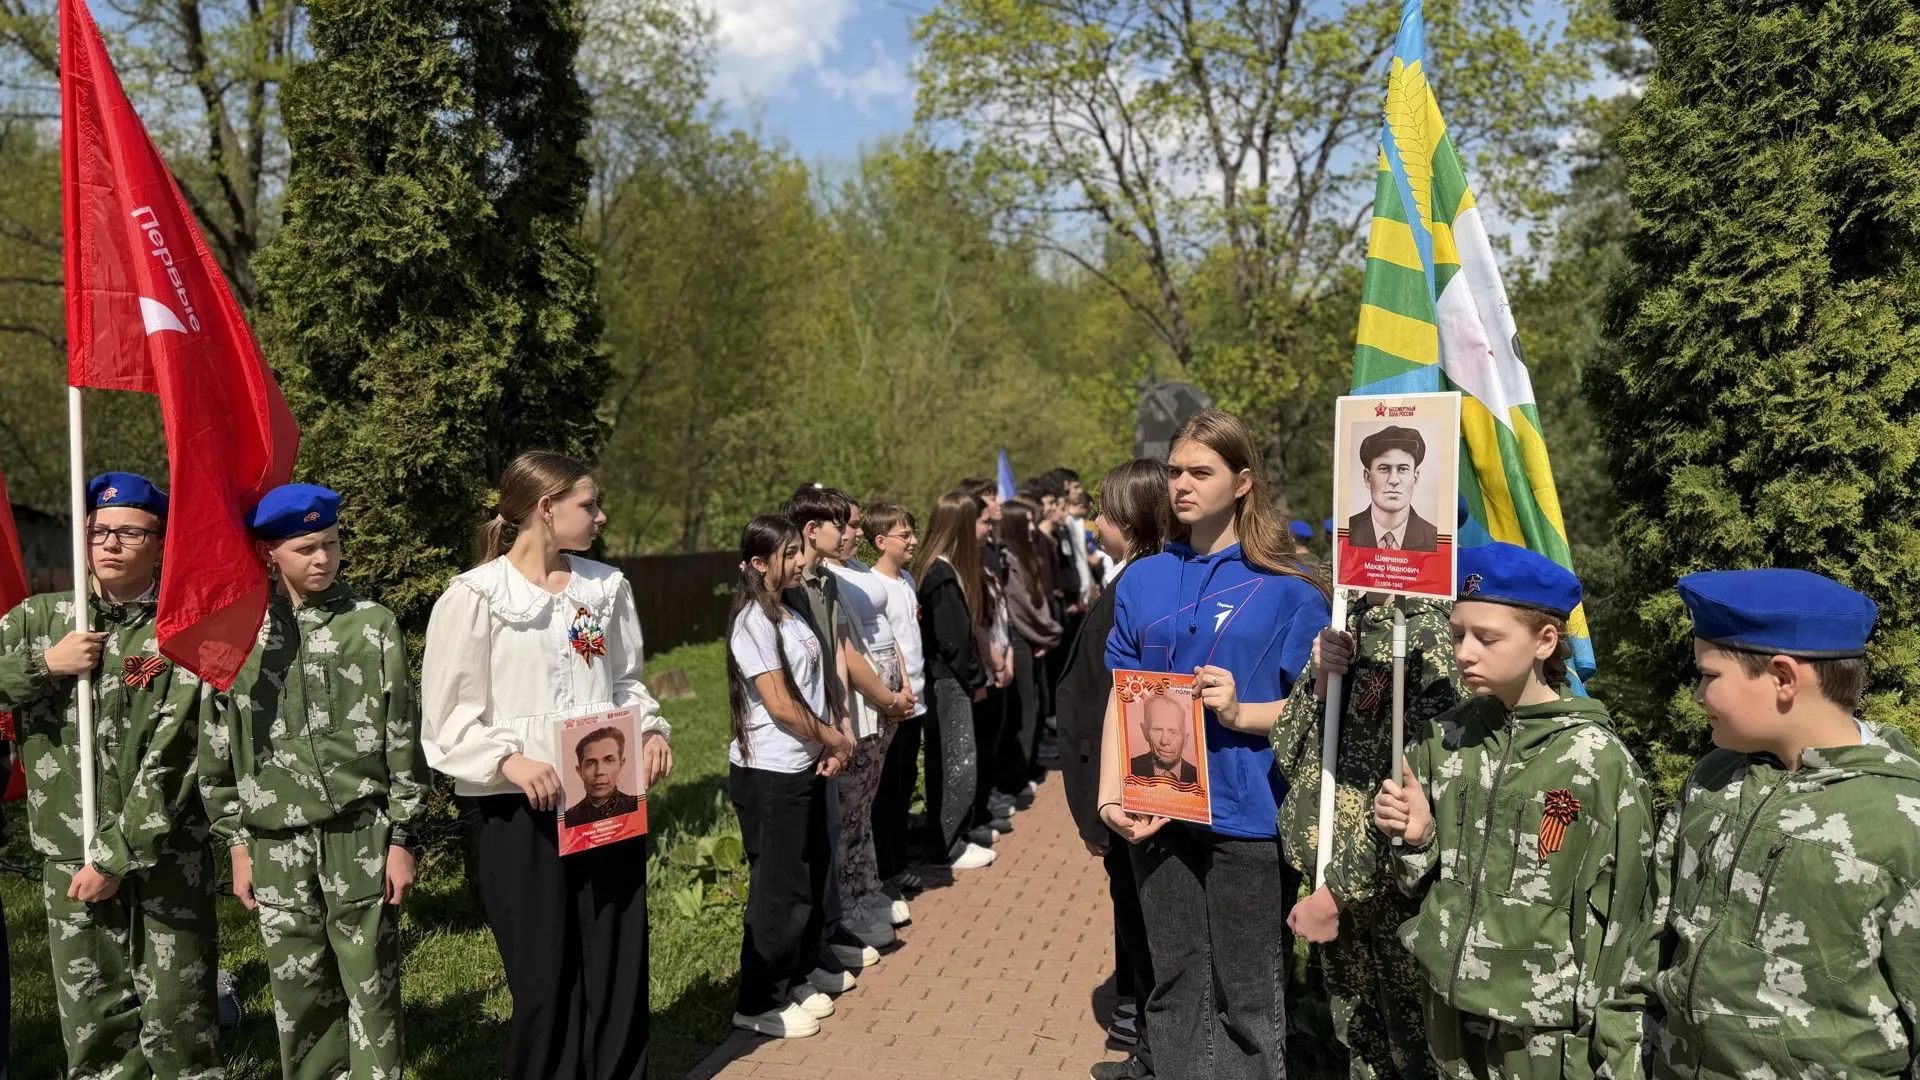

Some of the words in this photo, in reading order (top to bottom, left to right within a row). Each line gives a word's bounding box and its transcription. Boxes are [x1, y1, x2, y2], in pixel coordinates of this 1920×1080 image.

[130, 206, 200, 333] Первые
[1374, 554, 1409, 564] Шевченко
[1364, 562, 1386, 571] Макар
[1386, 564, 1420, 574] Иванович
